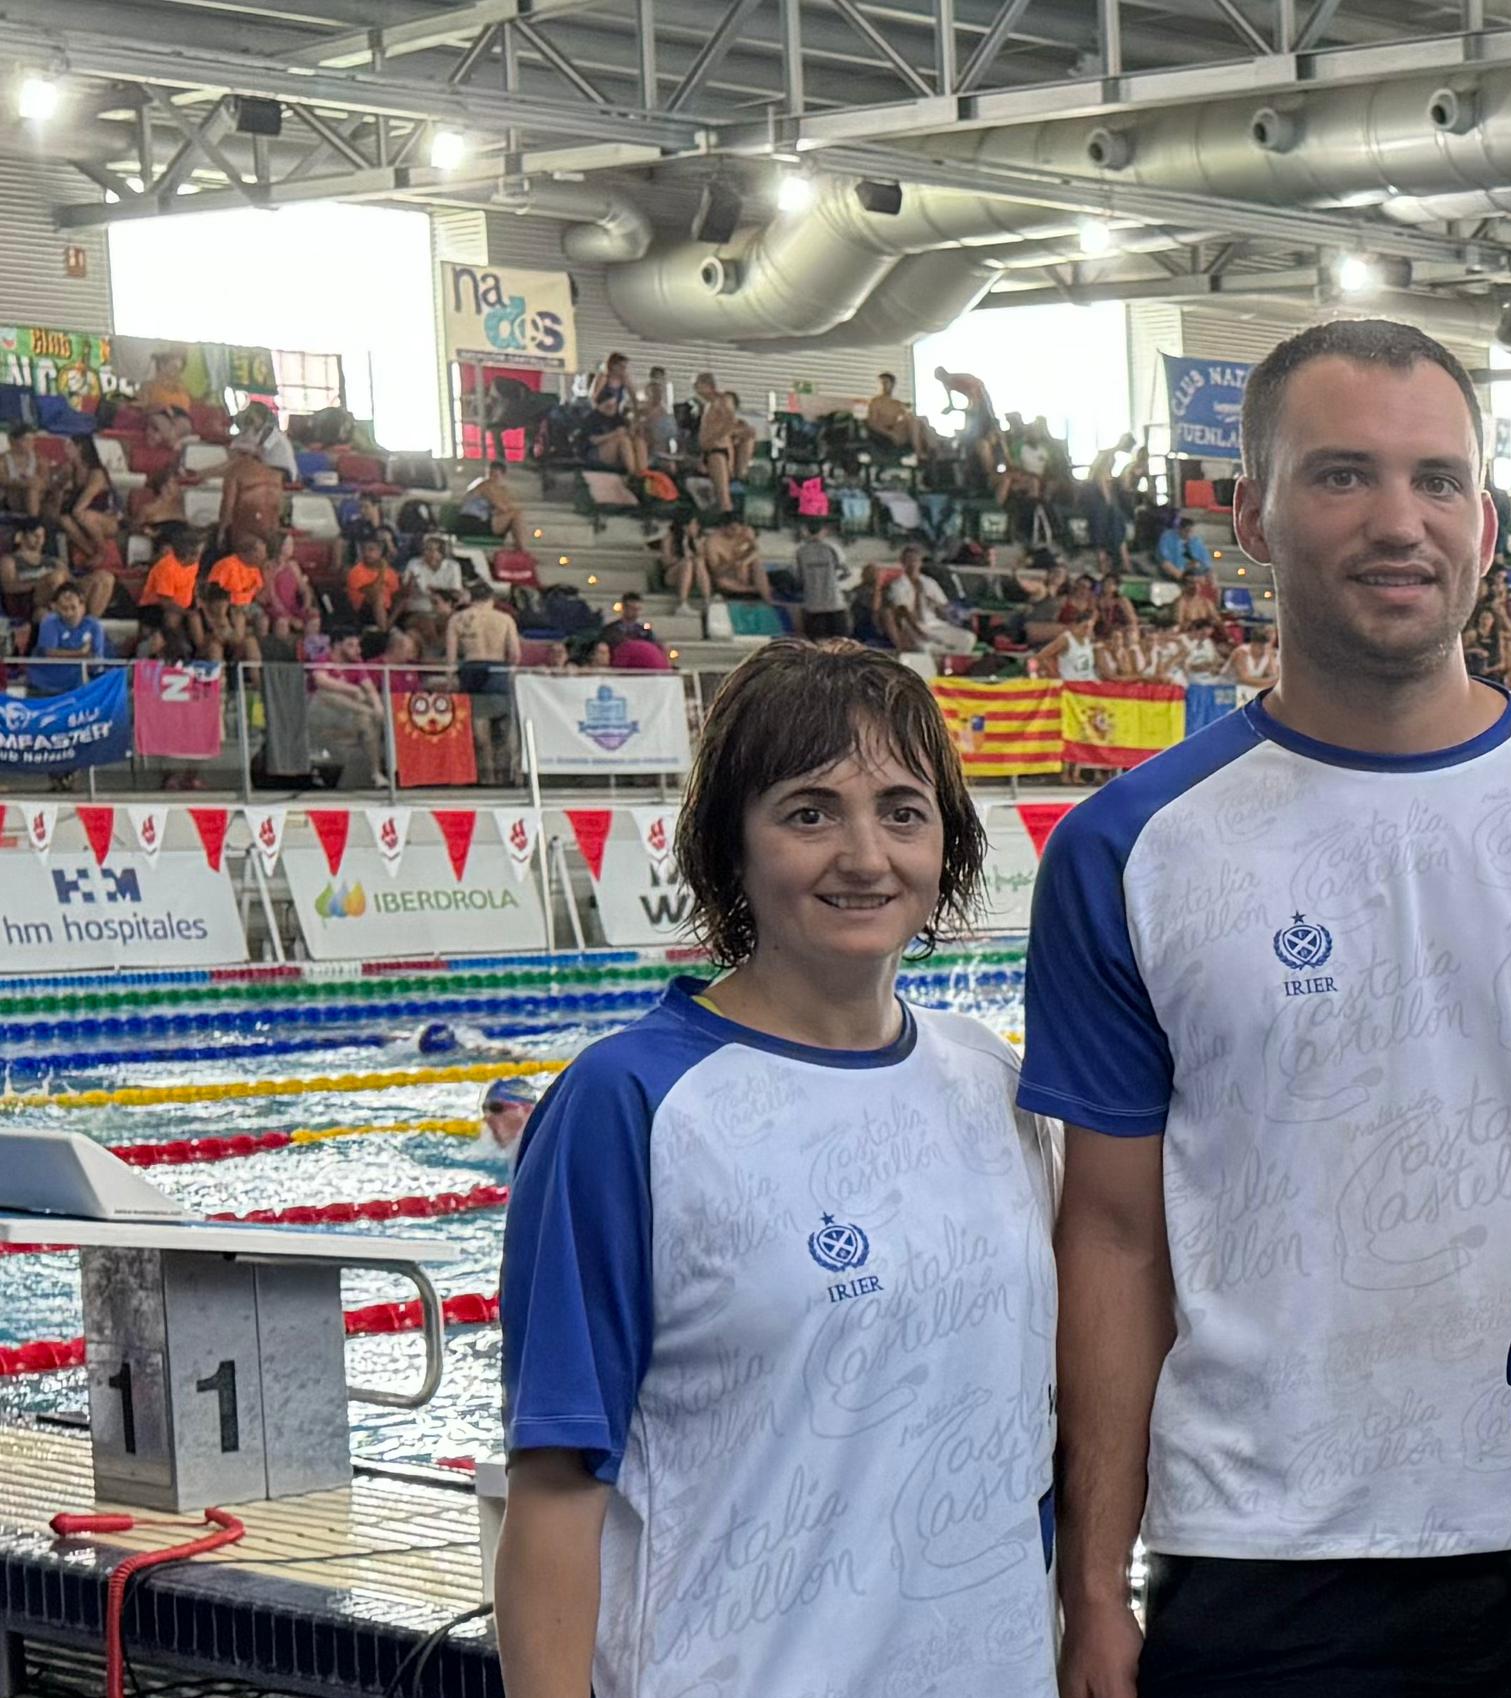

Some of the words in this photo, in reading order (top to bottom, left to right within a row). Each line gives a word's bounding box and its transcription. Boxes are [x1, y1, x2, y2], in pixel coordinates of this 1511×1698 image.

[374, 888, 519, 913] IBERDROLA
[3, 915, 52, 946] hm
[63, 911, 208, 945] hospitales
[1283, 976, 1338, 998] IRIER
[827, 1275, 885, 1304] IRIER
[109, 1361, 137, 1457] 1
[196, 1360, 239, 1454] 1
